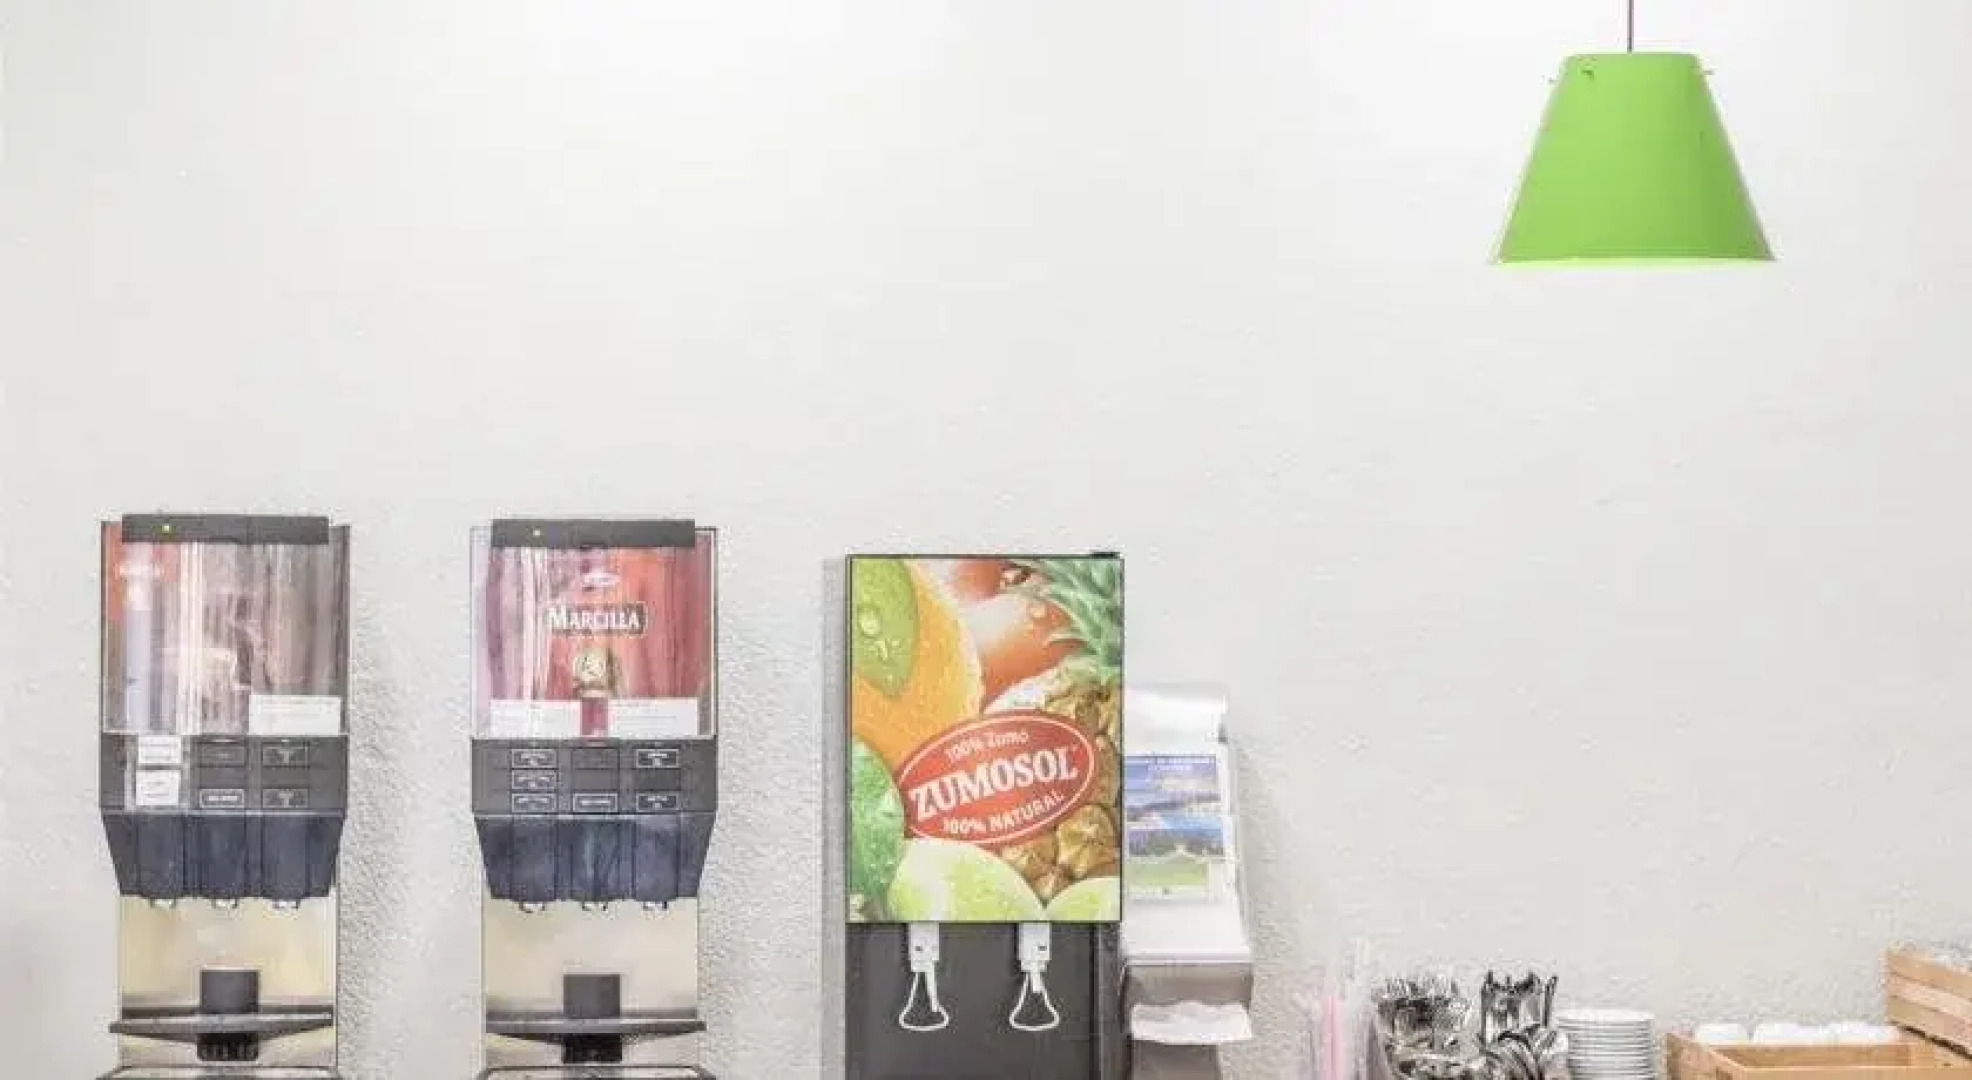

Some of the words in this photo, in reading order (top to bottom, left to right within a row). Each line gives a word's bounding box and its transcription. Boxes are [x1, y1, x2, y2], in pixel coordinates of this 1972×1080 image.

[547, 605, 641, 630] MARCILLA
[943, 736, 984, 763] 100%
[986, 731, 1030, 748] Zumo
[908, 747, 1079, 824] ZUMOSOL
[942, 817, 987, 834] 100%
[989, 790, 1064, 831] NATURAL
